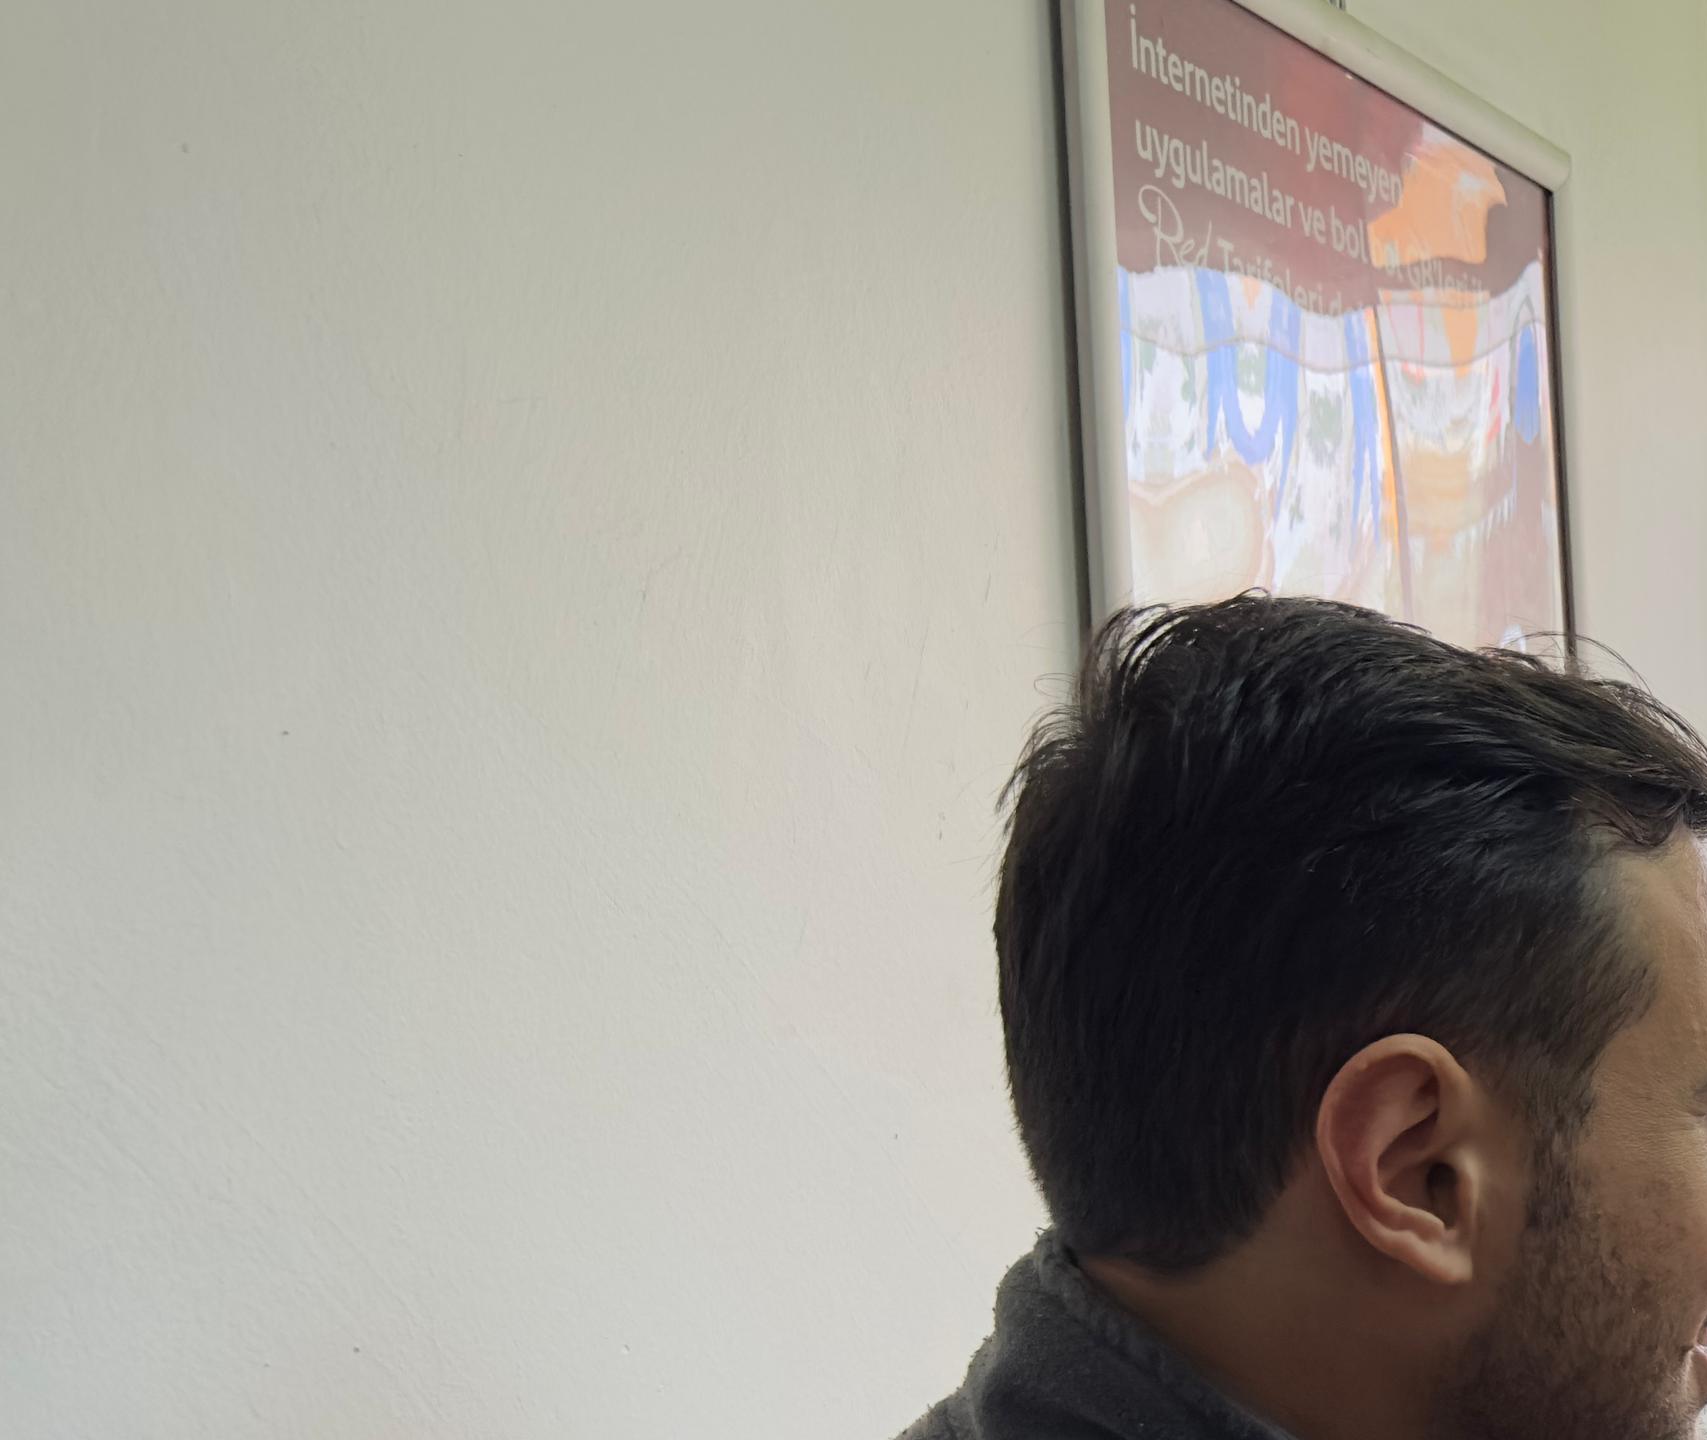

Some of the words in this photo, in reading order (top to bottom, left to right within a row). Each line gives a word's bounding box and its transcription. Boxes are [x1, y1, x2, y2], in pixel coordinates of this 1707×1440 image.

[1129, 4, 1300, 155] İnternetinden
[1304, 126, 1403, 206] yemeyen
[1136, 119, 1295, 229] uygulamalar
[1299, 201, 1327, 244] ve
[1331, 205, 1369, 265] bol
